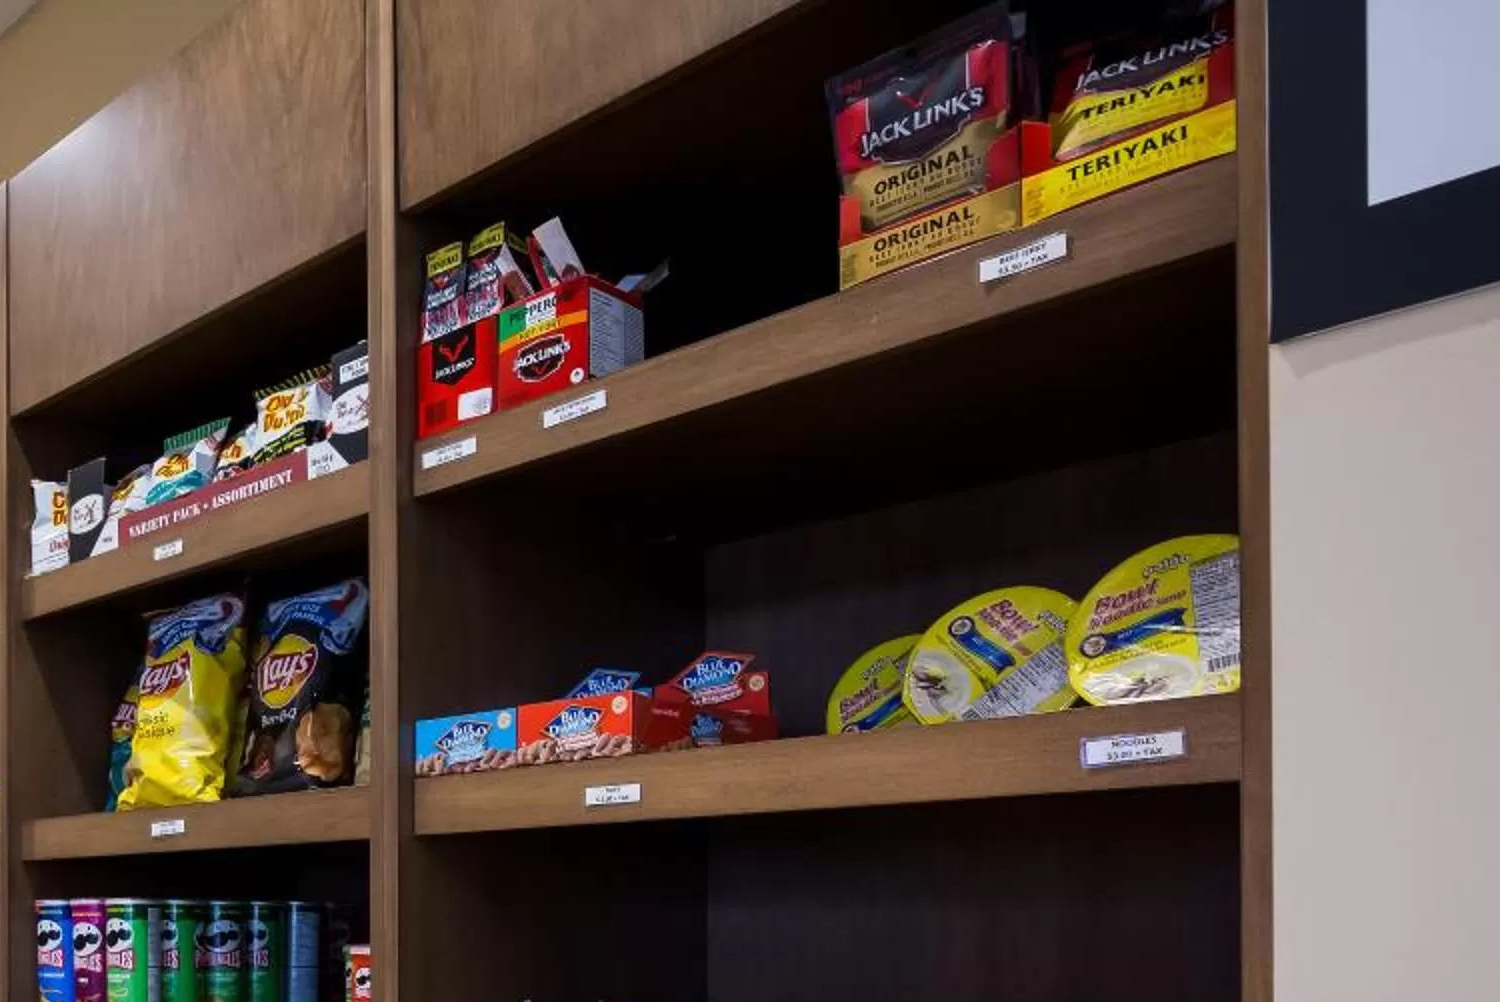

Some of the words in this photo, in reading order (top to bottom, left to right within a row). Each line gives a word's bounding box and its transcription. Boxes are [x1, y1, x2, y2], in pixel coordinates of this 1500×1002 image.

[1081, 73, 1205, 120] TERIYAKI
[860, 117, 912, 157] JACK
[1066, 125, 1189, 181] TERIYAKI
[874, 145, 975, 195] ORIGINAL
[873, 206, 975, 252] ORIGINAL
[128, 511, 171, 538] VARIETY
[173, 503, 201, 524] PACK
[263, 652, 314, 693] Lay's
[683, 661, 742, 691] DIAMOND
[696, 659, 725, 676] BLUE
[1111, 736, 1157, 748] NOODLES
